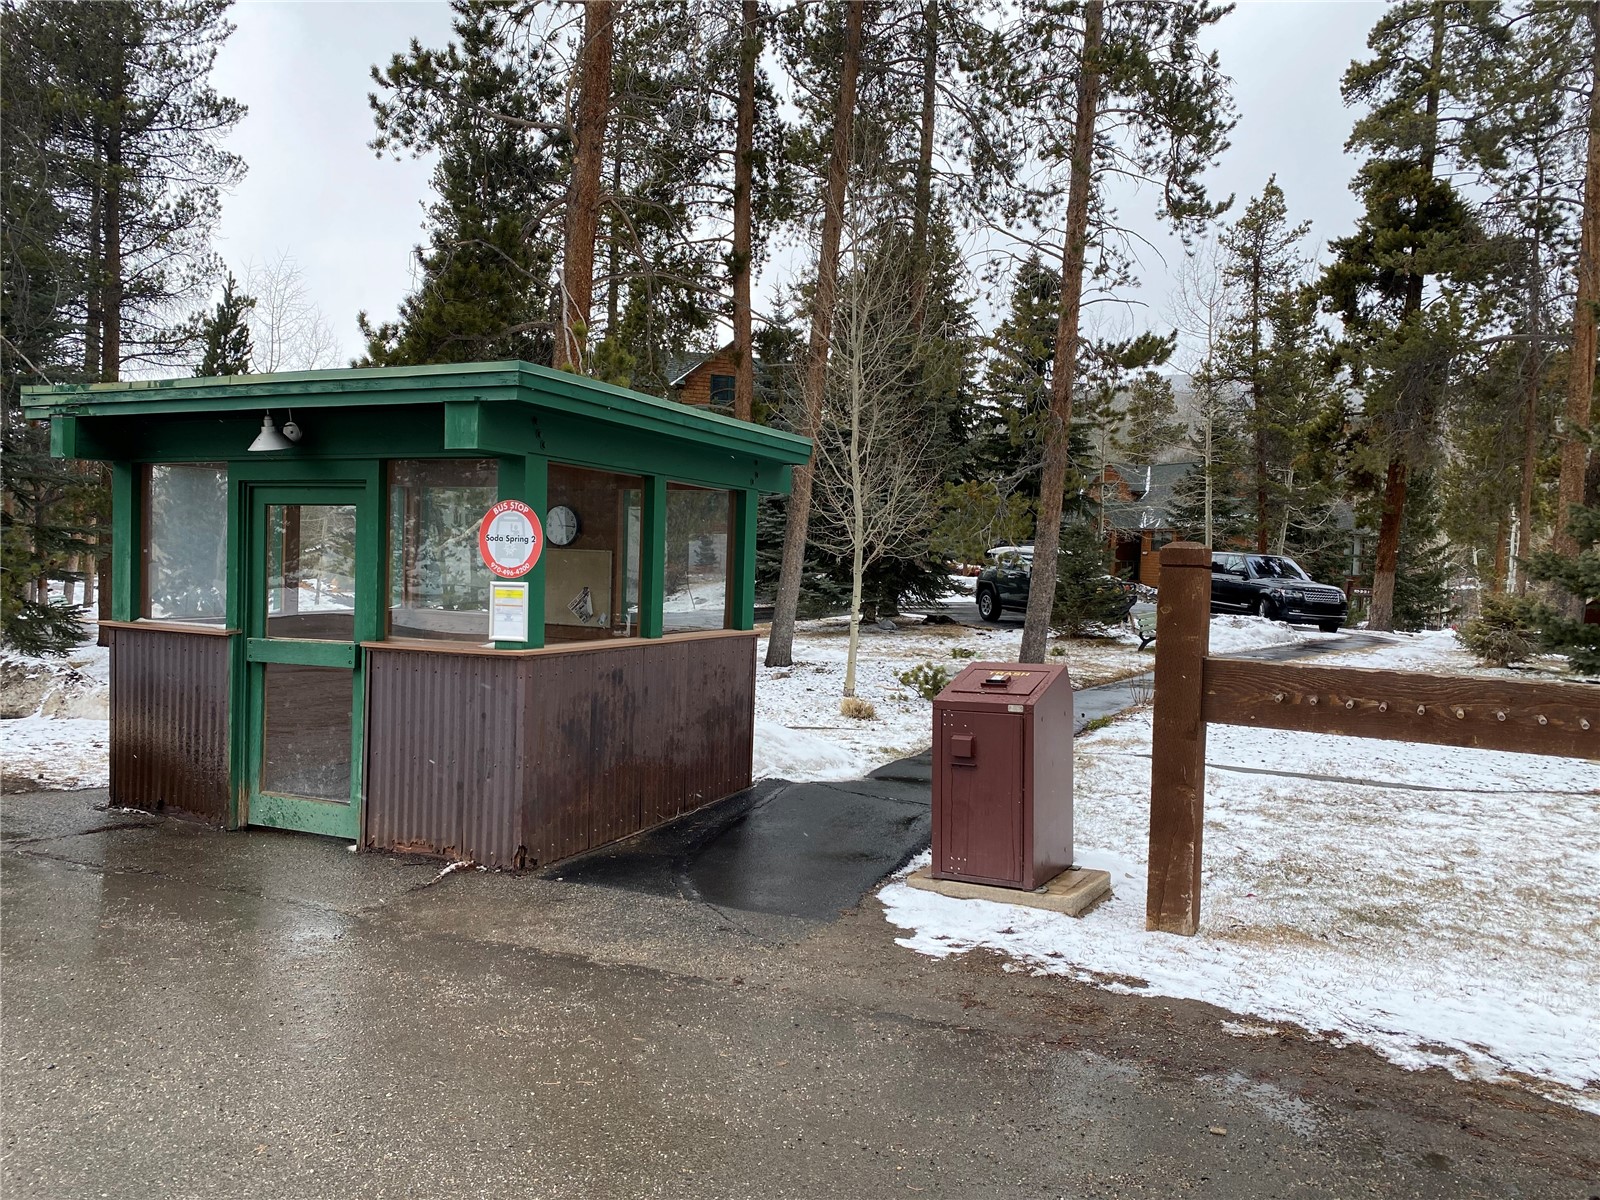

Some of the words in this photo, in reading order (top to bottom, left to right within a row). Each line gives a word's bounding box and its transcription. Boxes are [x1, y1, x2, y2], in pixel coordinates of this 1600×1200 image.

[492, 502, 508, 515] BUS
[510, 501, 529, 513] STOP
[486, 534, 503, 542] Soda
[506, 534, 529, 545] Spring
[531, 535, 536, 543] 2
[490, 562, 530, 576] 970-496-4200
